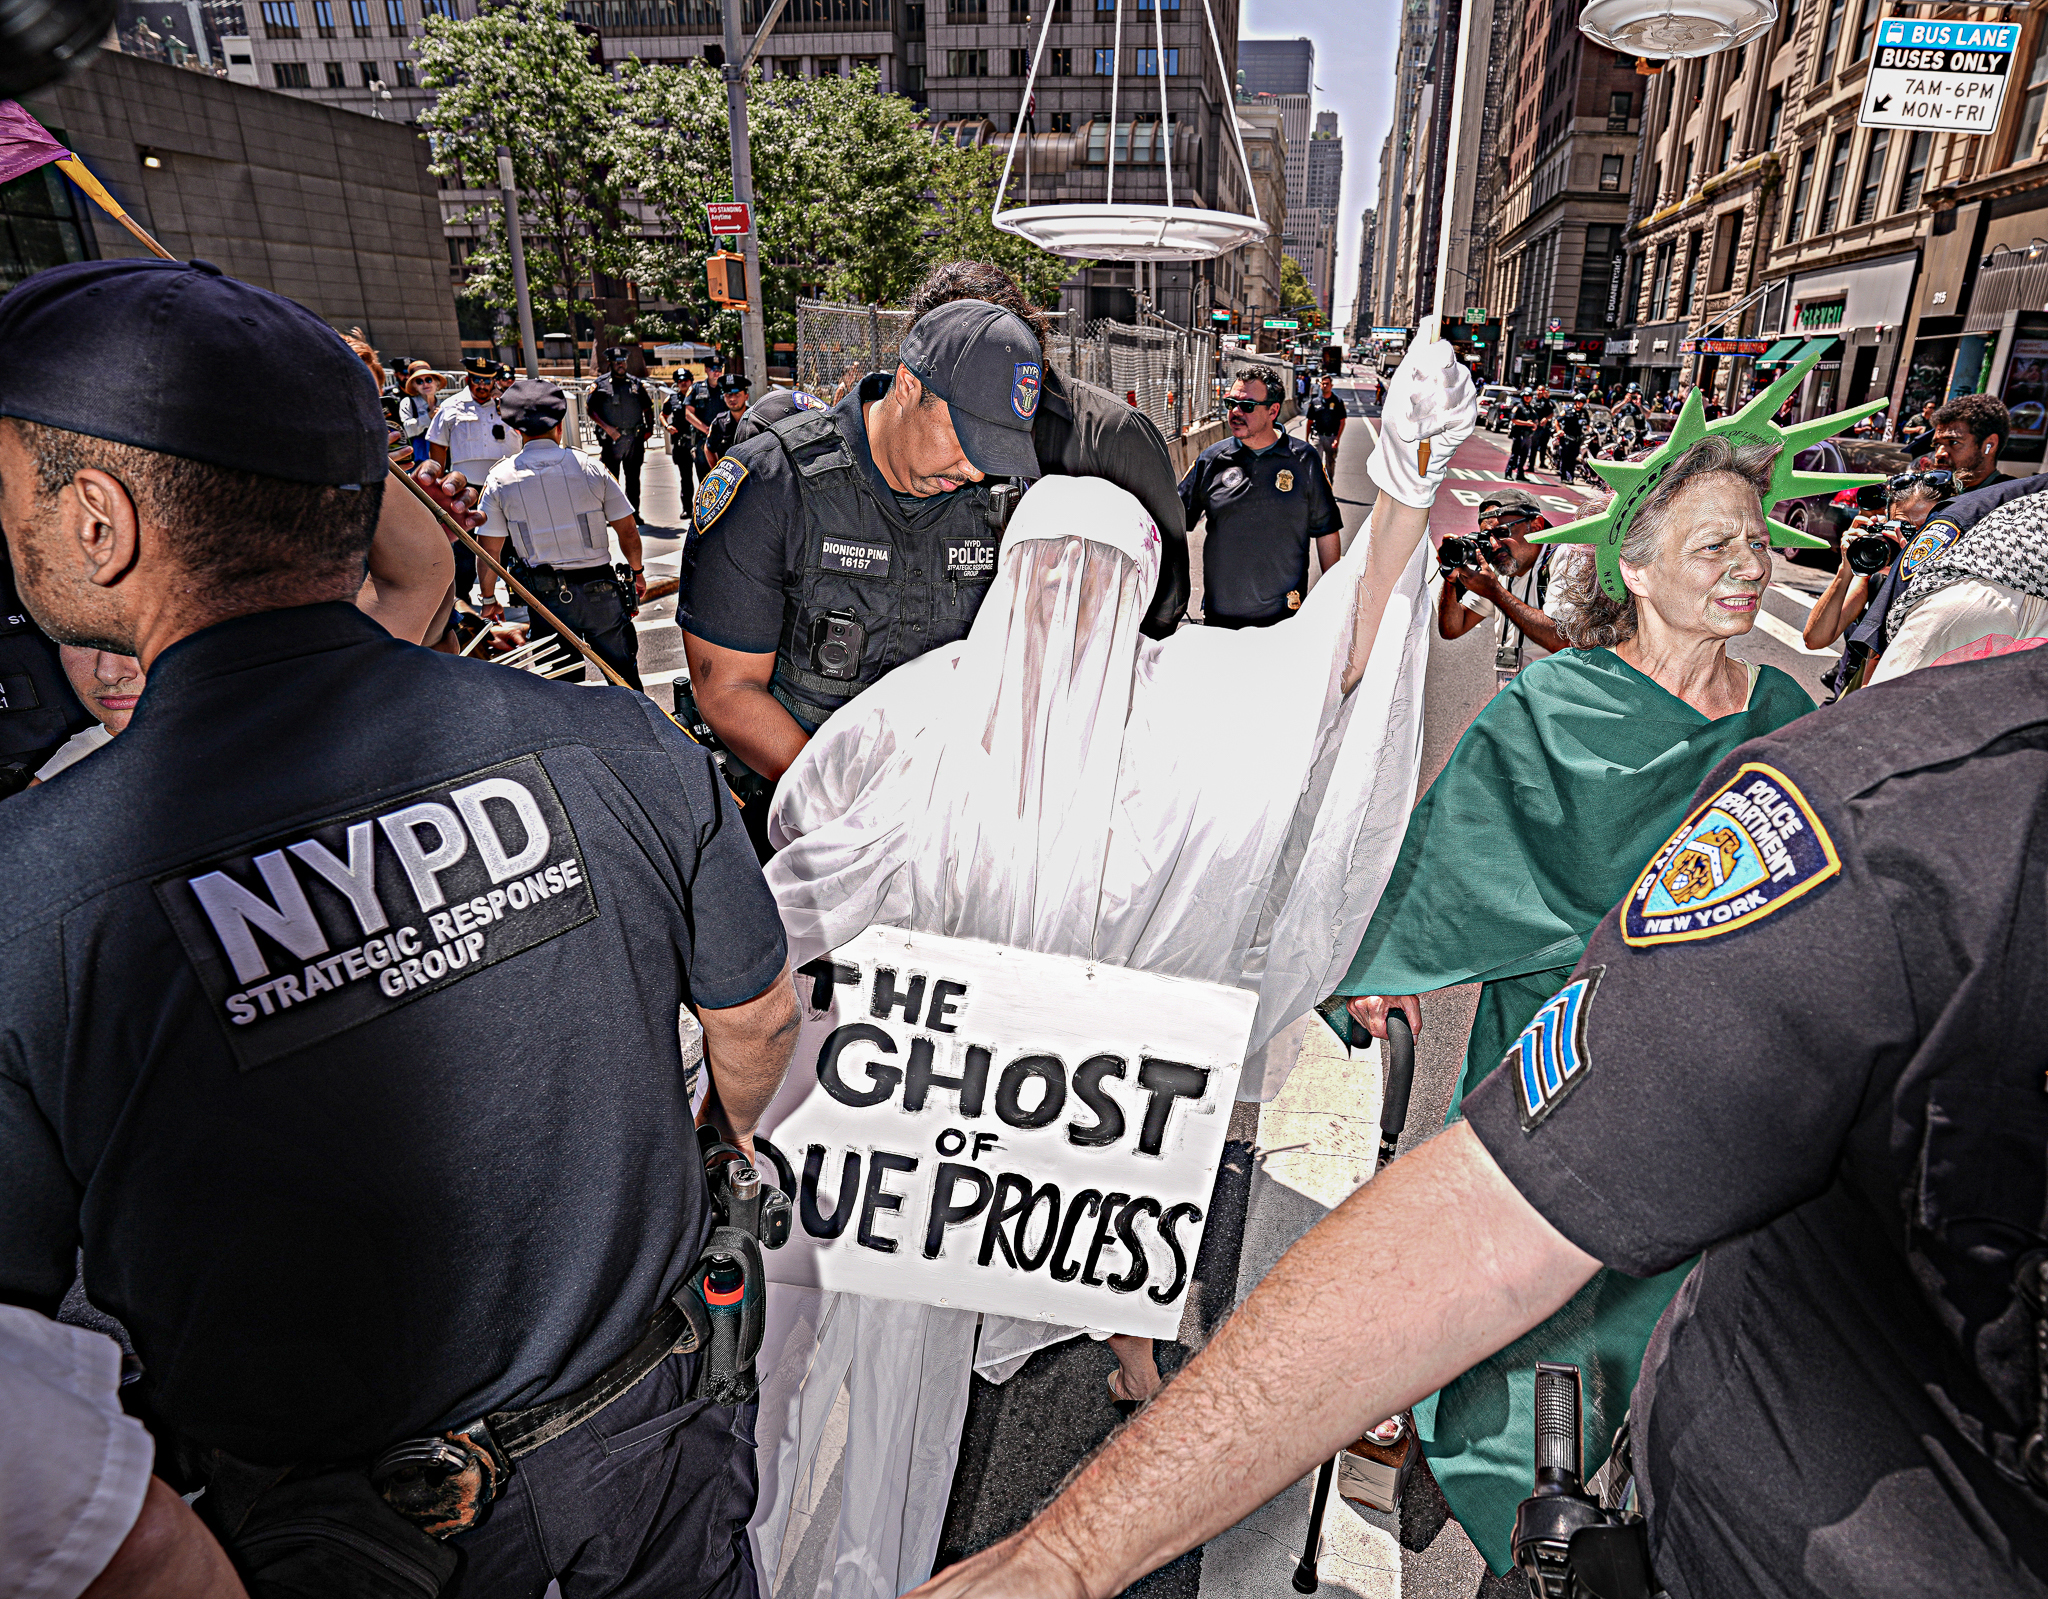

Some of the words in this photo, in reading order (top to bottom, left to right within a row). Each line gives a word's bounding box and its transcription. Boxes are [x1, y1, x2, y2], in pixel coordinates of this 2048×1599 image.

[1911, 26, 1951, 45] BUS
[1955, 28, 2011, 48] LANE
[1880, 48, 1945, 70] BUSES
[1950, 52, 2003, 73] ONLY
[1905, 78, 1995, 99] 7AM-6PM
[1901, 101, 1986, 122] MON-FRI
[1702, 341, 1737, 352] ATOMIC
[1738, 341, 1768, 354] WINGS
[1742, 431, 1769, 445] LIBER
[716, 490, 732, 511] YORK
[1450, 489, 1580, 513] BS
[823, 542, 866, 558] DIONICIO
[867, 549, 888, 561] PINA
[840, 556, 871, 569] 16157
[948, 547, 994, 564] POLICE
[1744, 780, 1804, 840] POLICE
[1711, 791, 1796, 883] DEPARTMENT
[188, 778, 551, 984] NYPD
[1643, 915, 1691, 933] NEW
[1695, 889, 1768, 927] YORK
[226, 925, 423, 1026] STRATEGIC
[428, 858, 583, 944] RESPONSE
[379, 931, 485, 998] GROUP
[798, 957, 968, 1034] THE
[816, 1023, 1211, 1157] GHOST
[934, 1128, 1000, 1161] OF
[922, 1162, 1204, 1305] PROCESS
